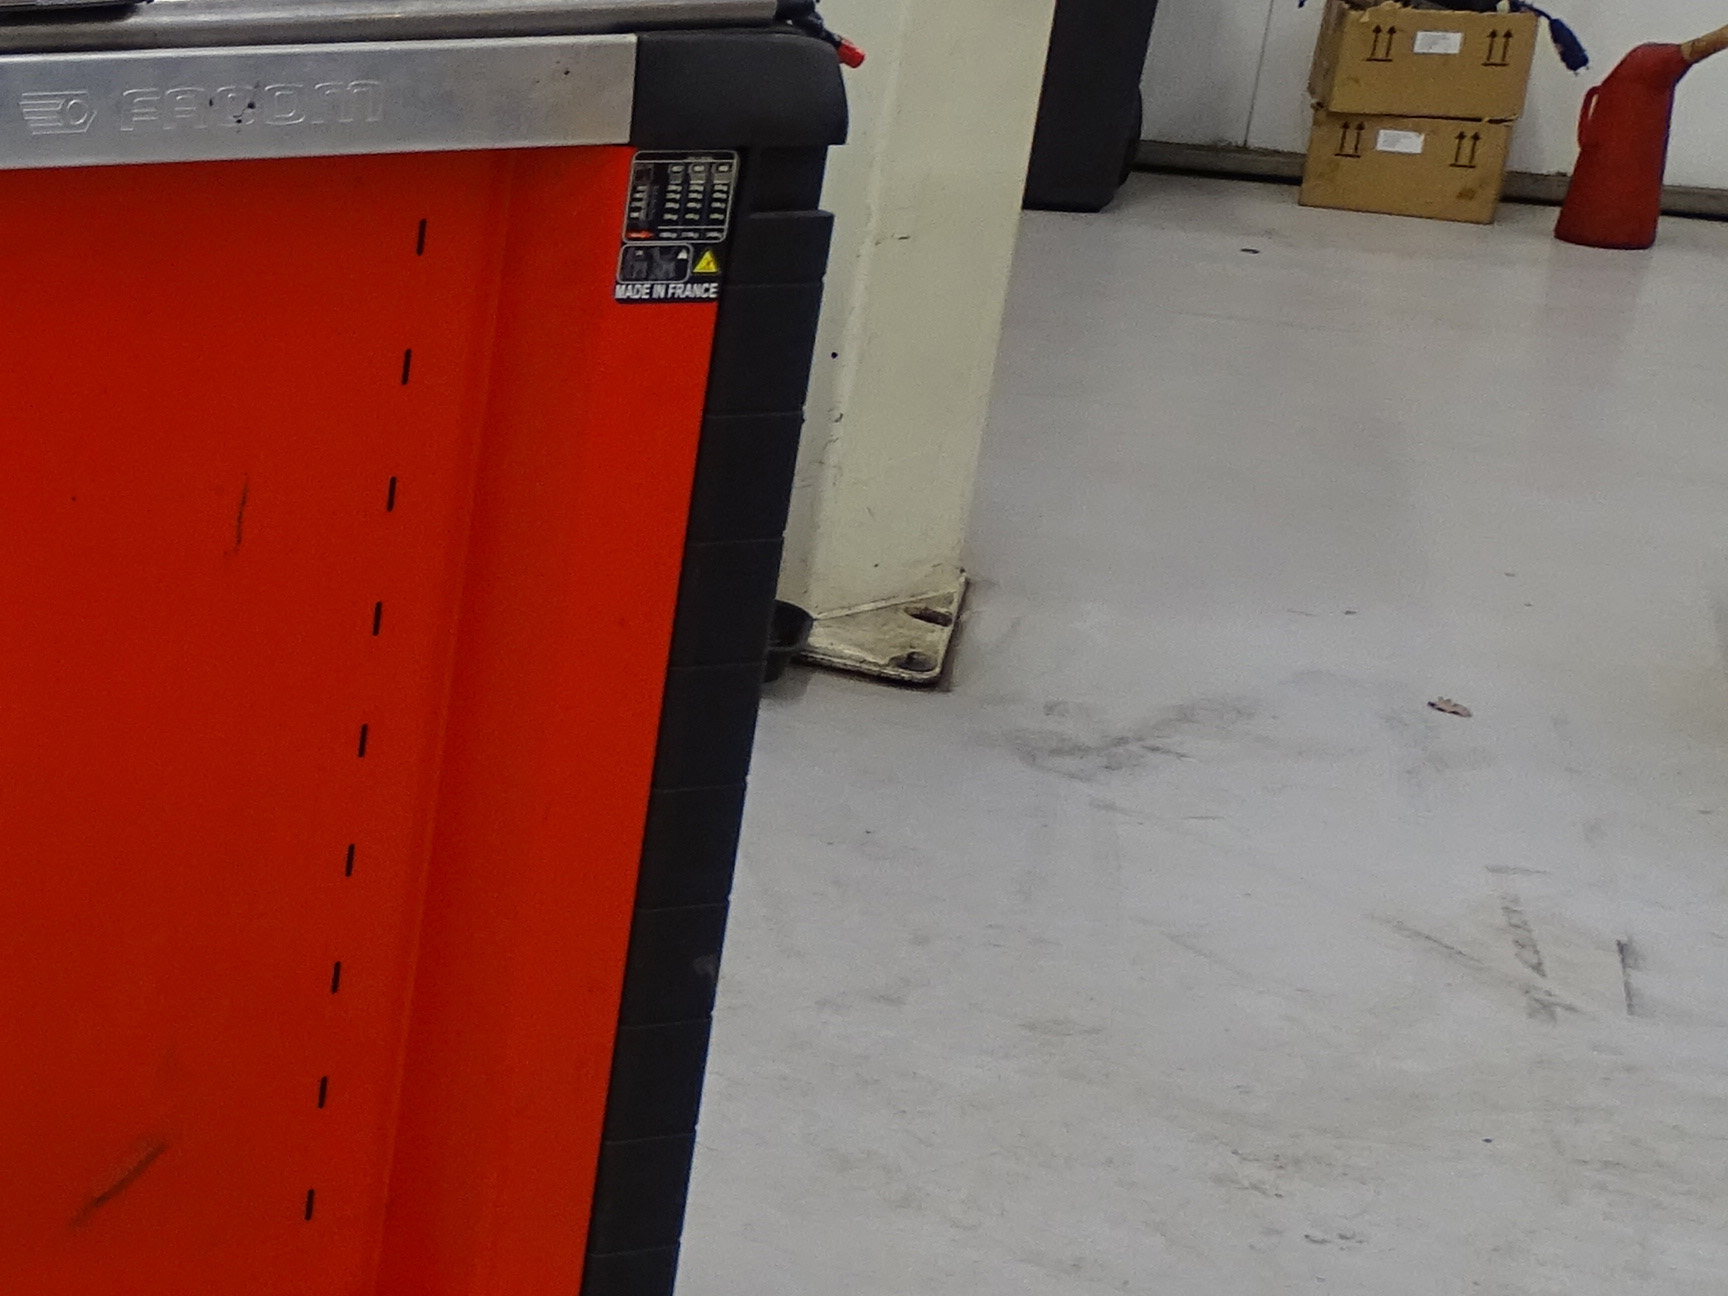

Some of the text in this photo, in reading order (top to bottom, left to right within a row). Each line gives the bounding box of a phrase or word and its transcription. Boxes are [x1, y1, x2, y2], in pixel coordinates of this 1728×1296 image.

[614, 282, 719, 300] MADE IN FRANCE
